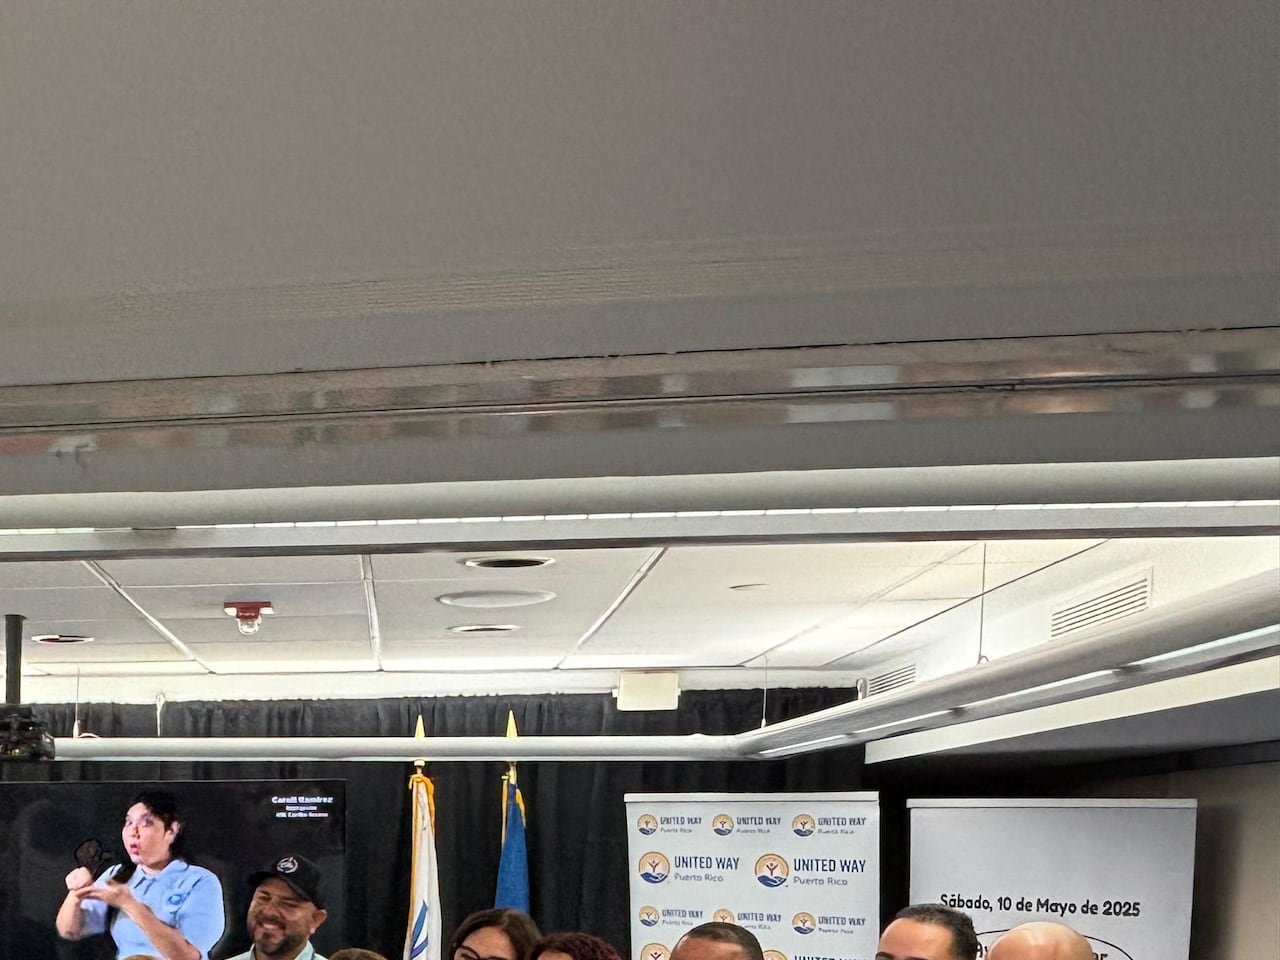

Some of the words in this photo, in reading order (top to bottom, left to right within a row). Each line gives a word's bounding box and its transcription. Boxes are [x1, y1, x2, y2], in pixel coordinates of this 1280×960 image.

[674, 856, 713, 870] UNITED
[716, 857, 740, 870] WAY
[793, 859, 837, 872] UNITED
[839, 860, 866, 873] WAY
[674, 873, 702, 881] Puerto
[705, 874, 723, 882] Rico
[794, 877, 824, 885] Puerto
[940, 893, 993, 912] Sábado,
[997, 897, 1012, 911] 10
[1016, 897, 1032, 912] de
[1036, 899, 1076, 917] Mayo
[1080, 900, 1098, 915] de
[1103, 901, 1140, 917] 2025
